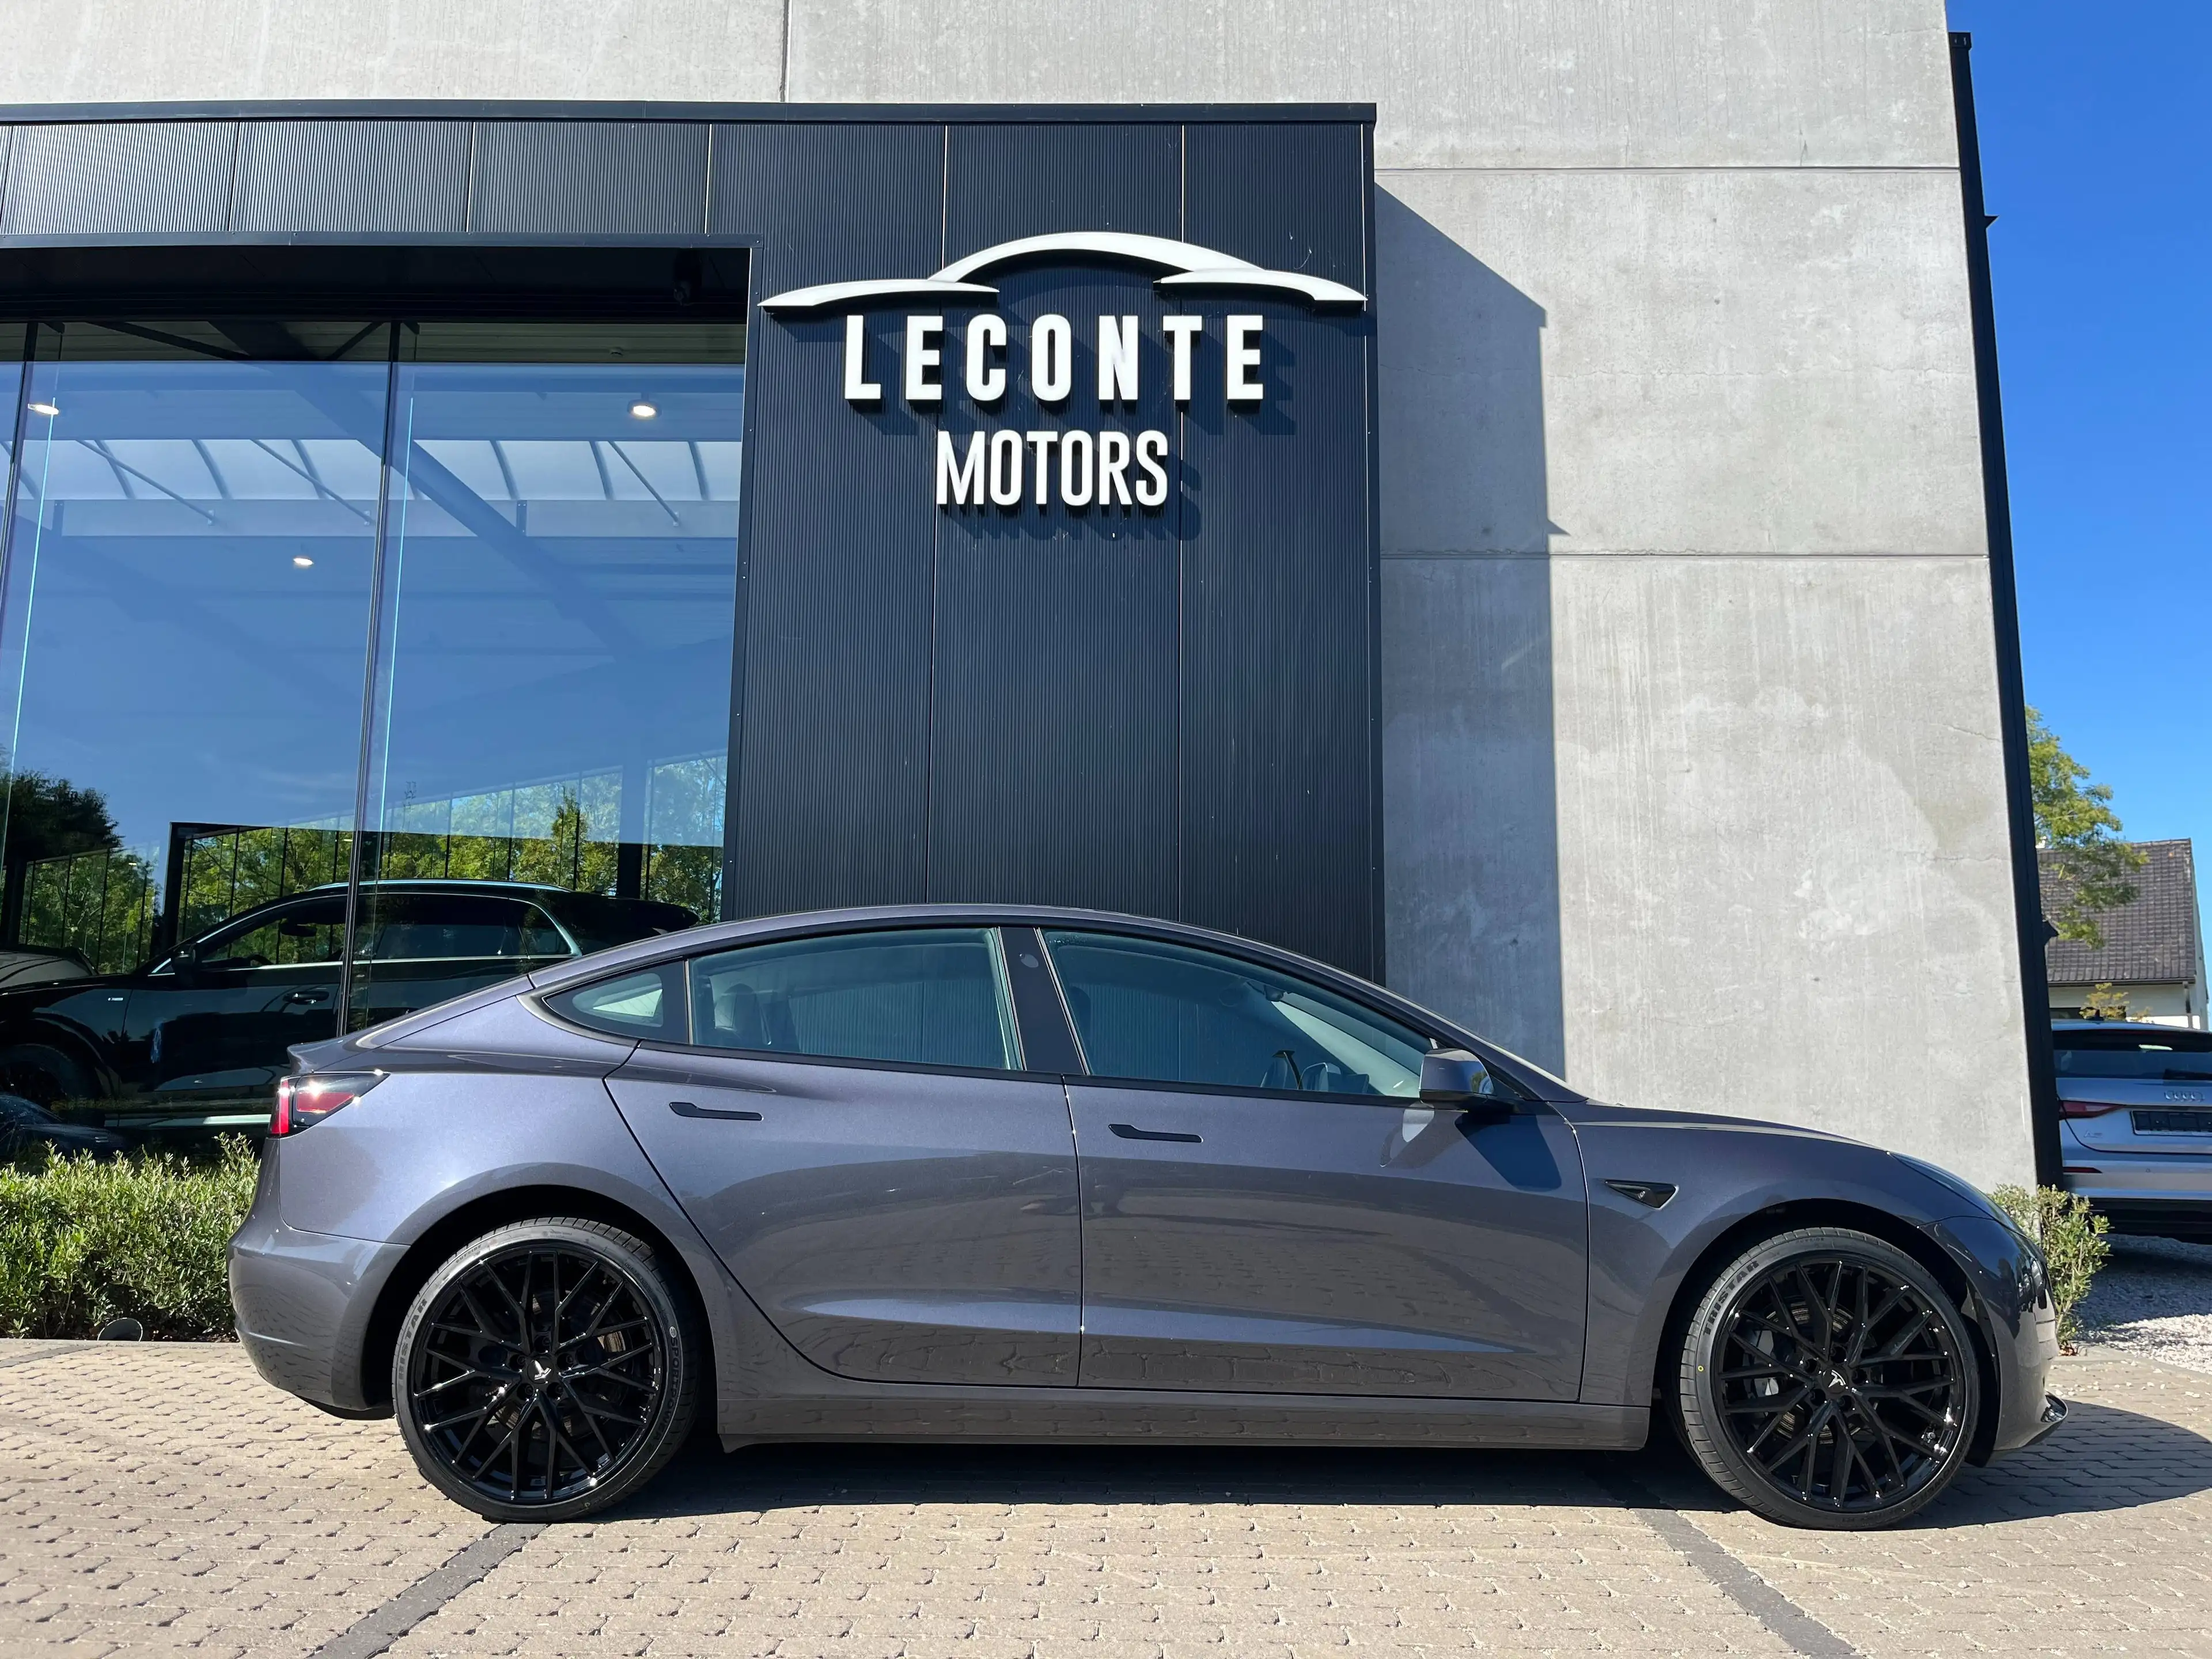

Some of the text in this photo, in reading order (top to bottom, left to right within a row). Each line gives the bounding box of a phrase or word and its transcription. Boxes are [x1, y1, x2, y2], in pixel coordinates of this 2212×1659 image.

[844, 313, 1264, 402] LECONTE
[935, 429, 1168, 507] MOTORS
[1703, 1260, 1760, 1335] TRISTAR
[653, 1337, 680, 1440] SPORTPOWER
